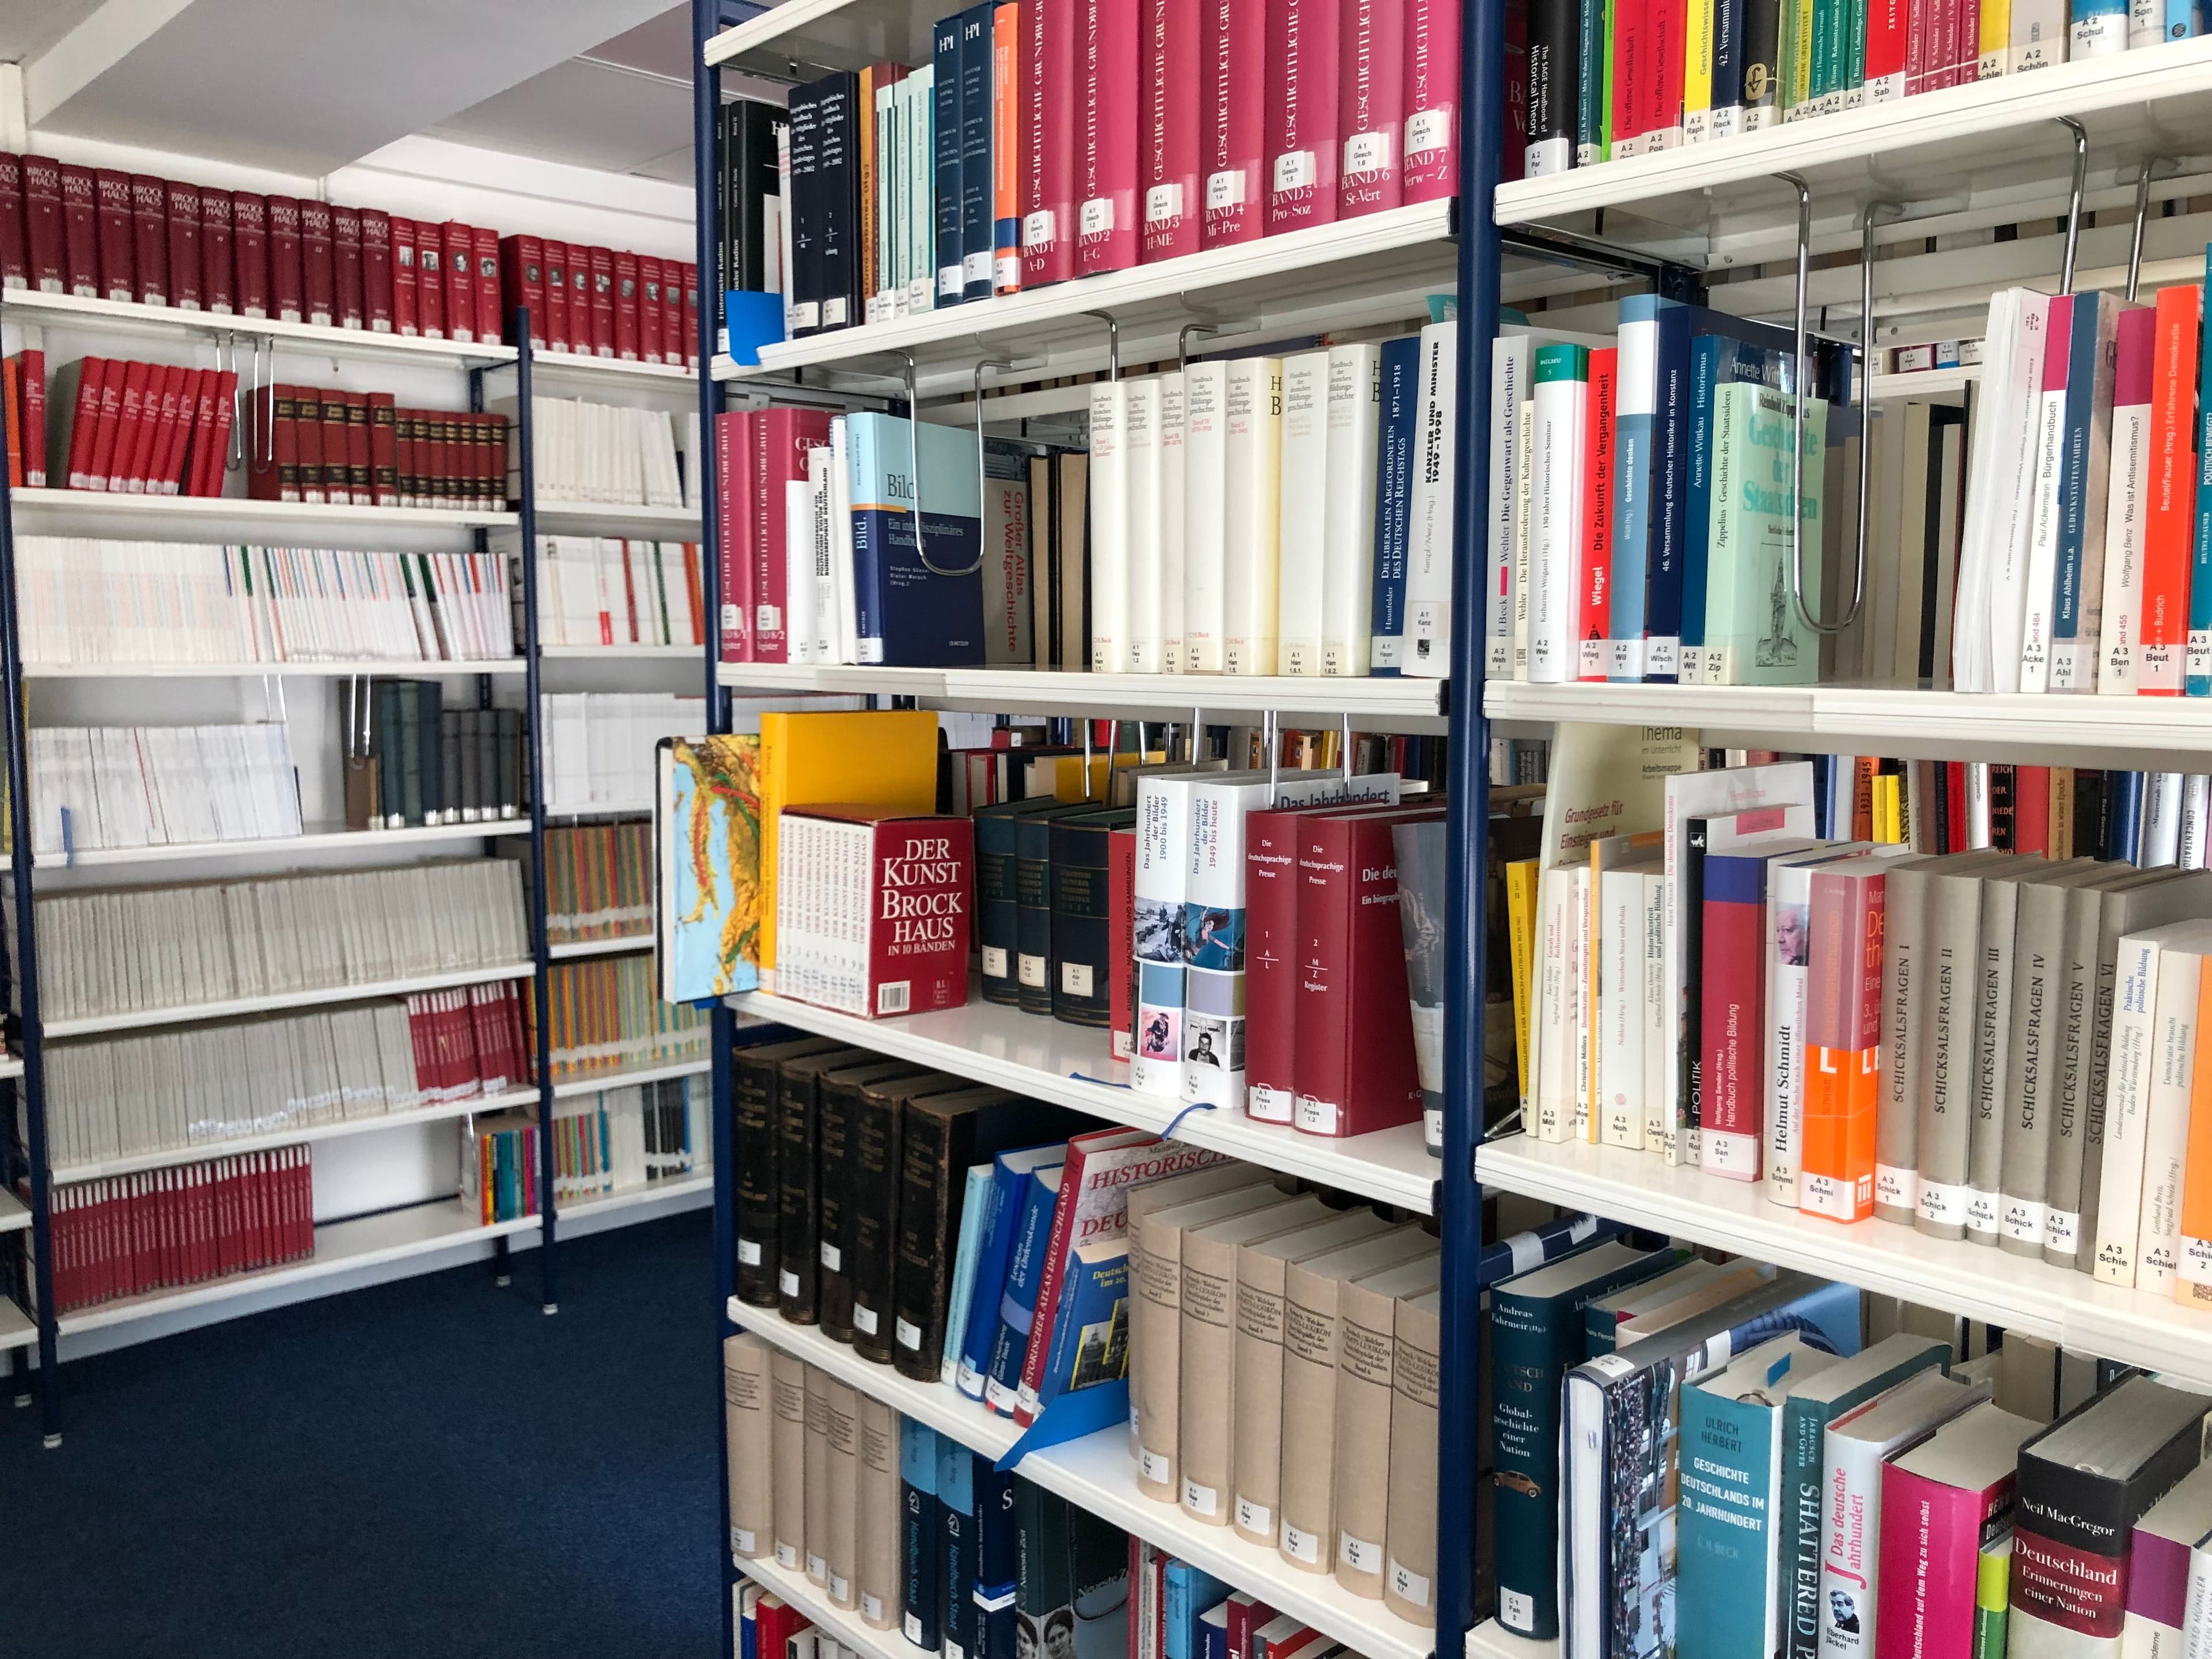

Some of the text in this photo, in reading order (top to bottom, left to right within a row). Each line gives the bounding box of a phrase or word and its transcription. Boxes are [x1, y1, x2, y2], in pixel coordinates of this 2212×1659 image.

[2077, 26, 2104, 40] Schul
[1286, 8, 1298, 149] GESCHICHTLICHE
[1529, 45, 1539, 136] Historical Theory
[1874, 88, 1889, 97] Sab
[1713, 120, 1730, 128] Reck
[1342, 170, 1378, 191] BAND
[1697, 353, 1706, 408] Historismus
[1425, 430, 1434, 483] KANZLER
[1430, 342, 1439, 396] MINISTER
[1722, 391, 1731, 441] Staatsideen
[2161, 323, 2180, 511] Beutel/Fauser Erfahrene Demokratie
[1501, 357, 1514, 562] Wehler Die Gegenwart als Geschichte
[1663, 501, 1673, 556] Versammlung
[1668, 370, 1676, 407] Konstanz
[1694, 453, 1702, 487] Annette
[2127, 416, 2140, 494] Antisemitismus?
[1592, 374, 1608, 605] Wiegel Die Zukunft der Vergangenheit
[1719, 456, 1729, 502] Geschichte
[2038, 402, 2057, 547] Paul Ackermann Bürgerhandbuch
[1014, 491, 1023, 550] Großer
[1717, 509, 1727, 547] Zippelius
[2124, 505, 2133, 523] Was
[857, 517, 868, 550] Bild.
[2124, 528, 2132, 549] Benz
[2064, 565, 2073, 596] Ahlheim
[2122, 550, 2133, 588] Wolfgang
[1003, 521, 1016, 652] Weltgeschichte
[2062, 598, 2071, 619] Klaus
[2154, 595, 2165, 626] Budrich
[1709, 664, 1721, 672] Zip
[904, 839, 950, 861] DER
[881, 857, 961, 887] KUNST
[1259, 869, 1275, 878] Presse
[1309, 876, 1327, 885] Presse
[1362, 869, 1380, 882] Die
[880, 889, 963, 919] BROCK
[1362, 896, 1371, 905] Ein
[893, 917, 953, 943] HAUS
[888, 940, 956, 956] IN BÄNDEN
[2138, 949, 2150, 1014] politische Bildung
[1894, 958, 1909, 1103] SCHICKSALSFRAGEN
[1936, 964, 1952, 1113] SCHICKSALSFRAGEN
[1980, 969, 1998, 1120] SCHICKSALSFRAGEN
[1726, 1004, 1740, 1127] Handbuch politische Bildung
[2022, 976, 2044, 1130] SCHICKSALSFRAGEN
[2062, 982, 2084, 1138] SCHICKSALSFRAGEN
[2089, 986, 2112, 1145] SCHICKSALSFRAGEN
[1692, 1060, 1700, 1114] POLITIK
[1775, 1025, 1791, 1153] Helmut Schmidt
[1715, 1093, 1723, 1124] Wolfgang
[1921, 1199, 1946, 1211] Schick
[2005, 1215, 2033, 1229] Schick
[1048, 1183, 1069, 1270] DEUTSCHLAND
[2099, 1254, 2127, 1266] Schie
[2146, 1256, 2177, 1270] Schiel
[1492, 1313, 1528, 1331] Fahrmeir
[1498, 1304, 1532, 1318] Andreas
[1499, 1403, 1532, 1418] Global-
[1705, 1416, 1738, 1436] ULRICH
[1499, 1441, 1530, 1457] Nation
[1503, 1431, 1525, 1444] einer
[1702, 1433, 1742, 1453] HERBERT
[1808, 1417, 1819, 1463] JARAUSCH
[1694, 1457, 1749, 1484] GESCHICHTE
[1681, 1473, 1764, 1510] DEUTSCHLANDS IM
[1682, 1495, 1762, 1532] 20. JAHRHUNDERT
[1831, 1468, 1846, 1557] Das deutsche
[2022, 1497, 2115, 1537] Neil MacGregor
[1798, 1483, 1820, 1636] SHATTERED
[1916, 1501, 1930, 1611] auf dem Weg zu sich selbst
[2016, 1537, 2117, 1585] Deutschland
[2024, 1565, 2103, 1602] Erinnerungen
[2025, 1586, 2096, 1618] einer Nation
[1826, 1637, 1847, 1650] Jäckel
[1827, 1627, 1859, 1645] Eberhard
